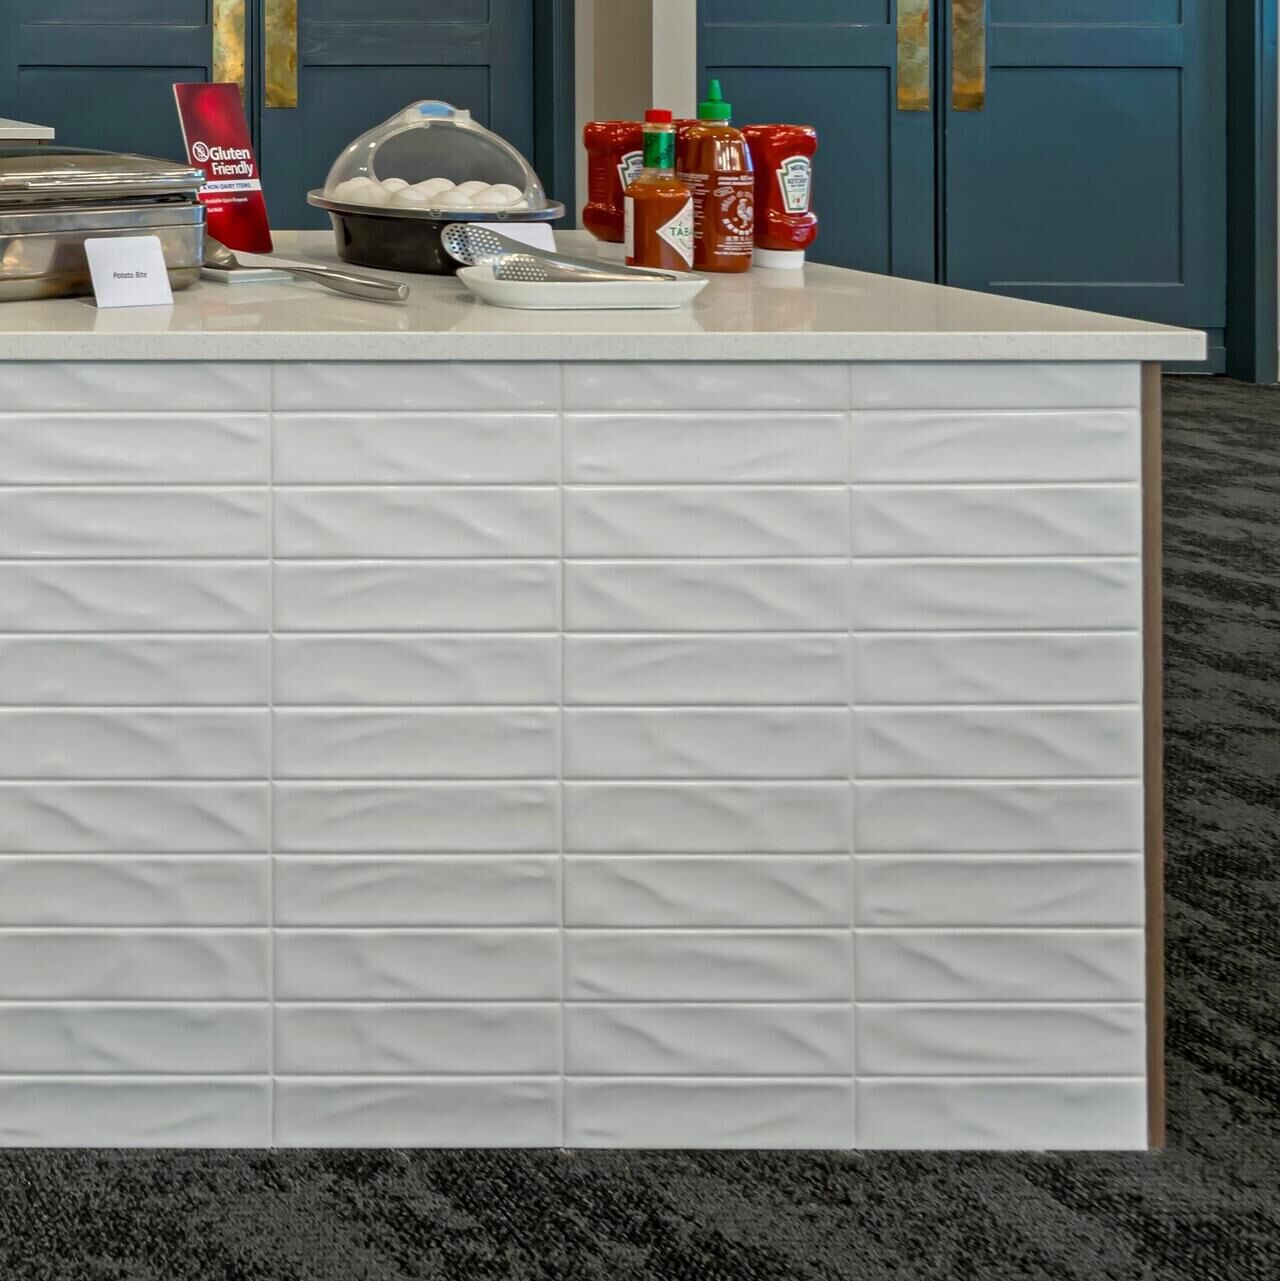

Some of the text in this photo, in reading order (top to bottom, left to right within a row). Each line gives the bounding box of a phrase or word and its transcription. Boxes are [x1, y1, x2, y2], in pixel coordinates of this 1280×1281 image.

[209, 146, 251, 161] Gluten
[211, 161, 254, 177] Friendly
[669, 226, 694, 237] TAB
[113, 271, 134, 280] Potato
